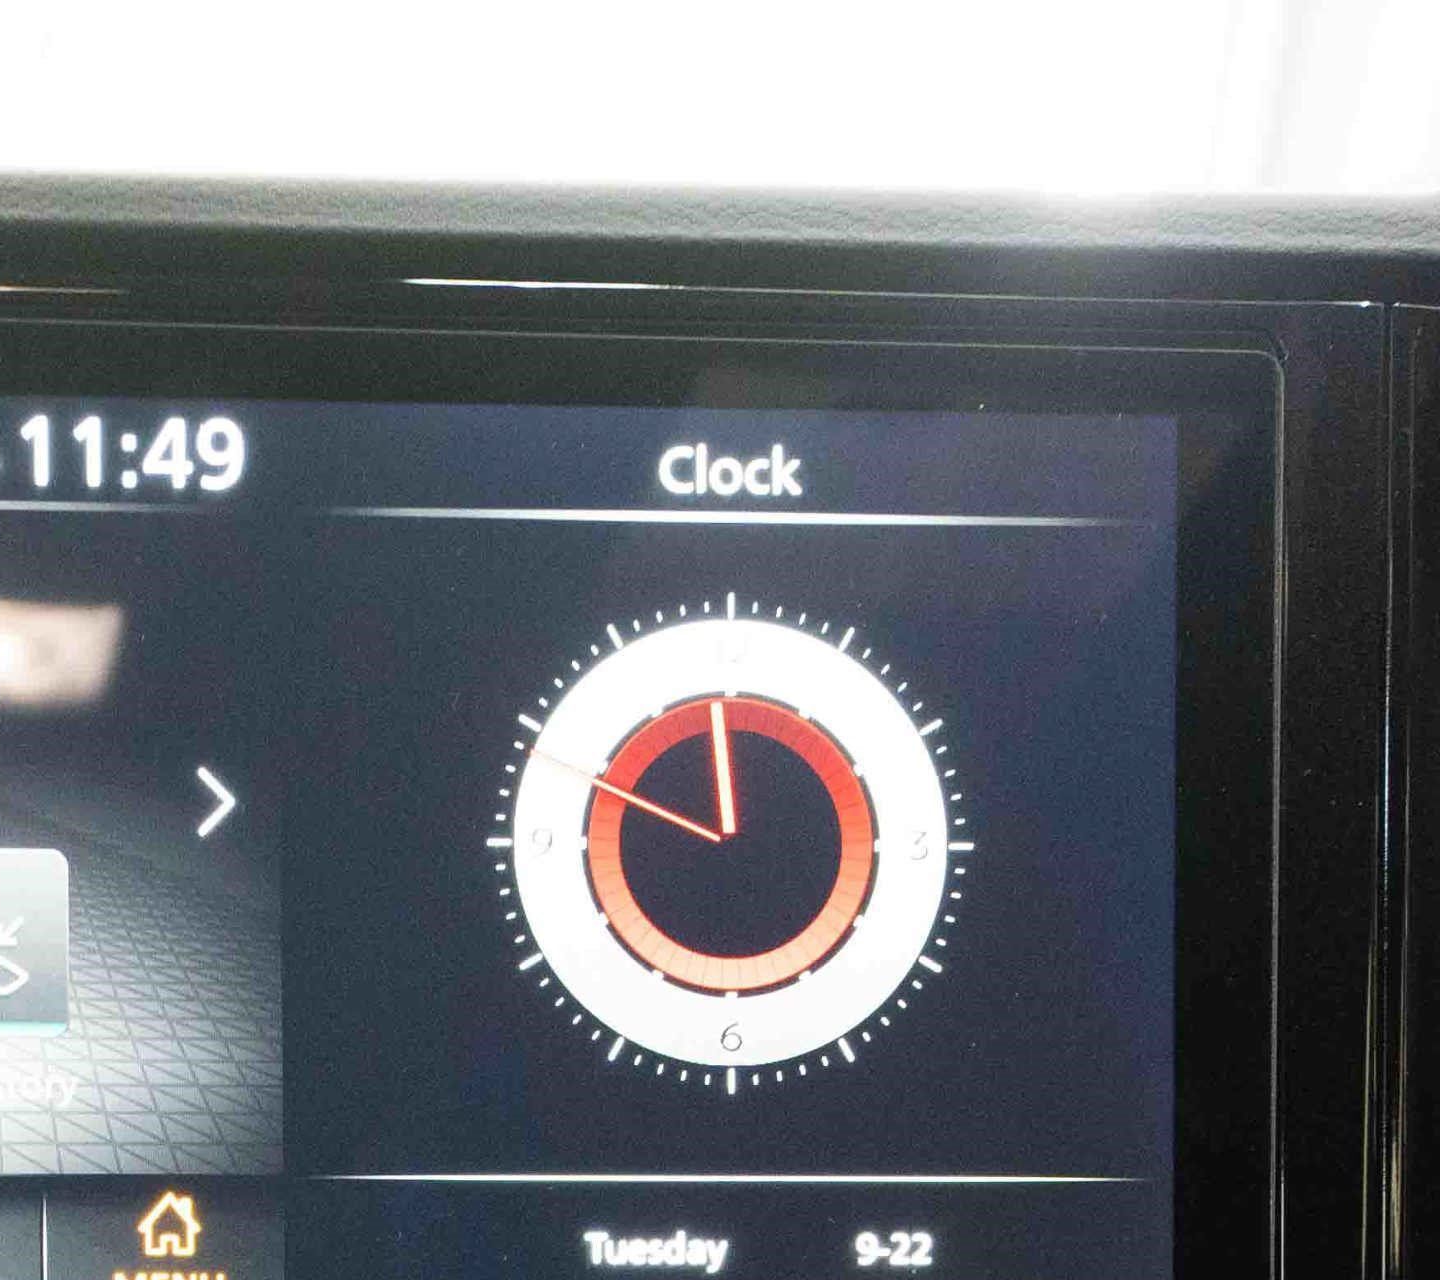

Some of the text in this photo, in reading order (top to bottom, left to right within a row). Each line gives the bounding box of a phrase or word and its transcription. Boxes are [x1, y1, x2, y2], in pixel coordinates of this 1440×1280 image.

[19, 414, 246, 492] 11:49
[658, 442, 804, 498] Clock
[719, 1021, 744, 1054] 6
[583, 1229, 728, 1274] Tuesday
[856, 1231, 934, 1267] 9-22
